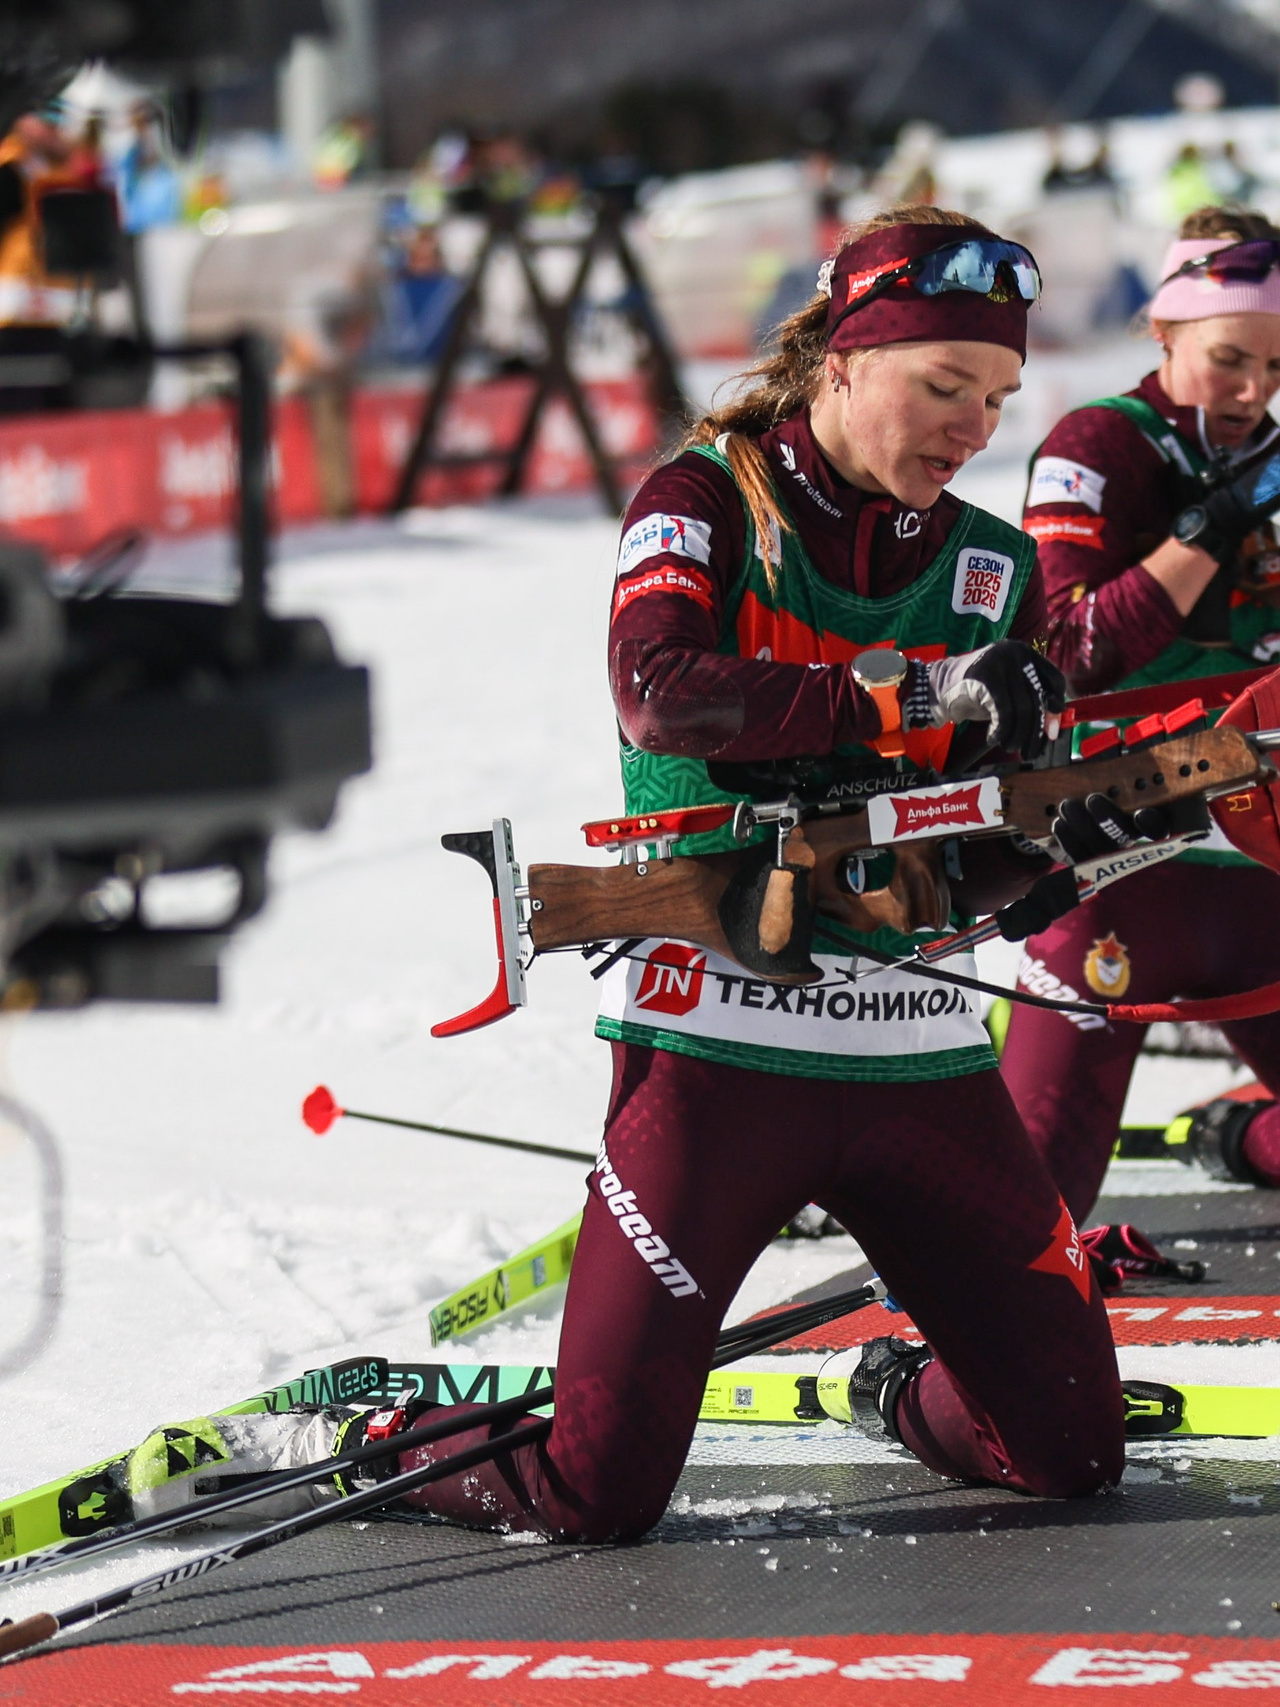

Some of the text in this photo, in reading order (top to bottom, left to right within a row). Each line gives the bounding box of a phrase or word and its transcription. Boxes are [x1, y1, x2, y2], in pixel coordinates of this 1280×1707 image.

[967, 555, 1005, 575] СЕЗОН
[666, 571, 703, 591] Бан
[965, 570, 1002, 592] 2025
[962, 588, 997, 611] 2026
[826, 773, 918, 798] ANSCHUTZ
[907, 802, 969, 824] Альфа Банк
[716, 976, 974, 1021] ТЕХНОНИКОЛ
[170, 1650, 973, 1693] Альфа
